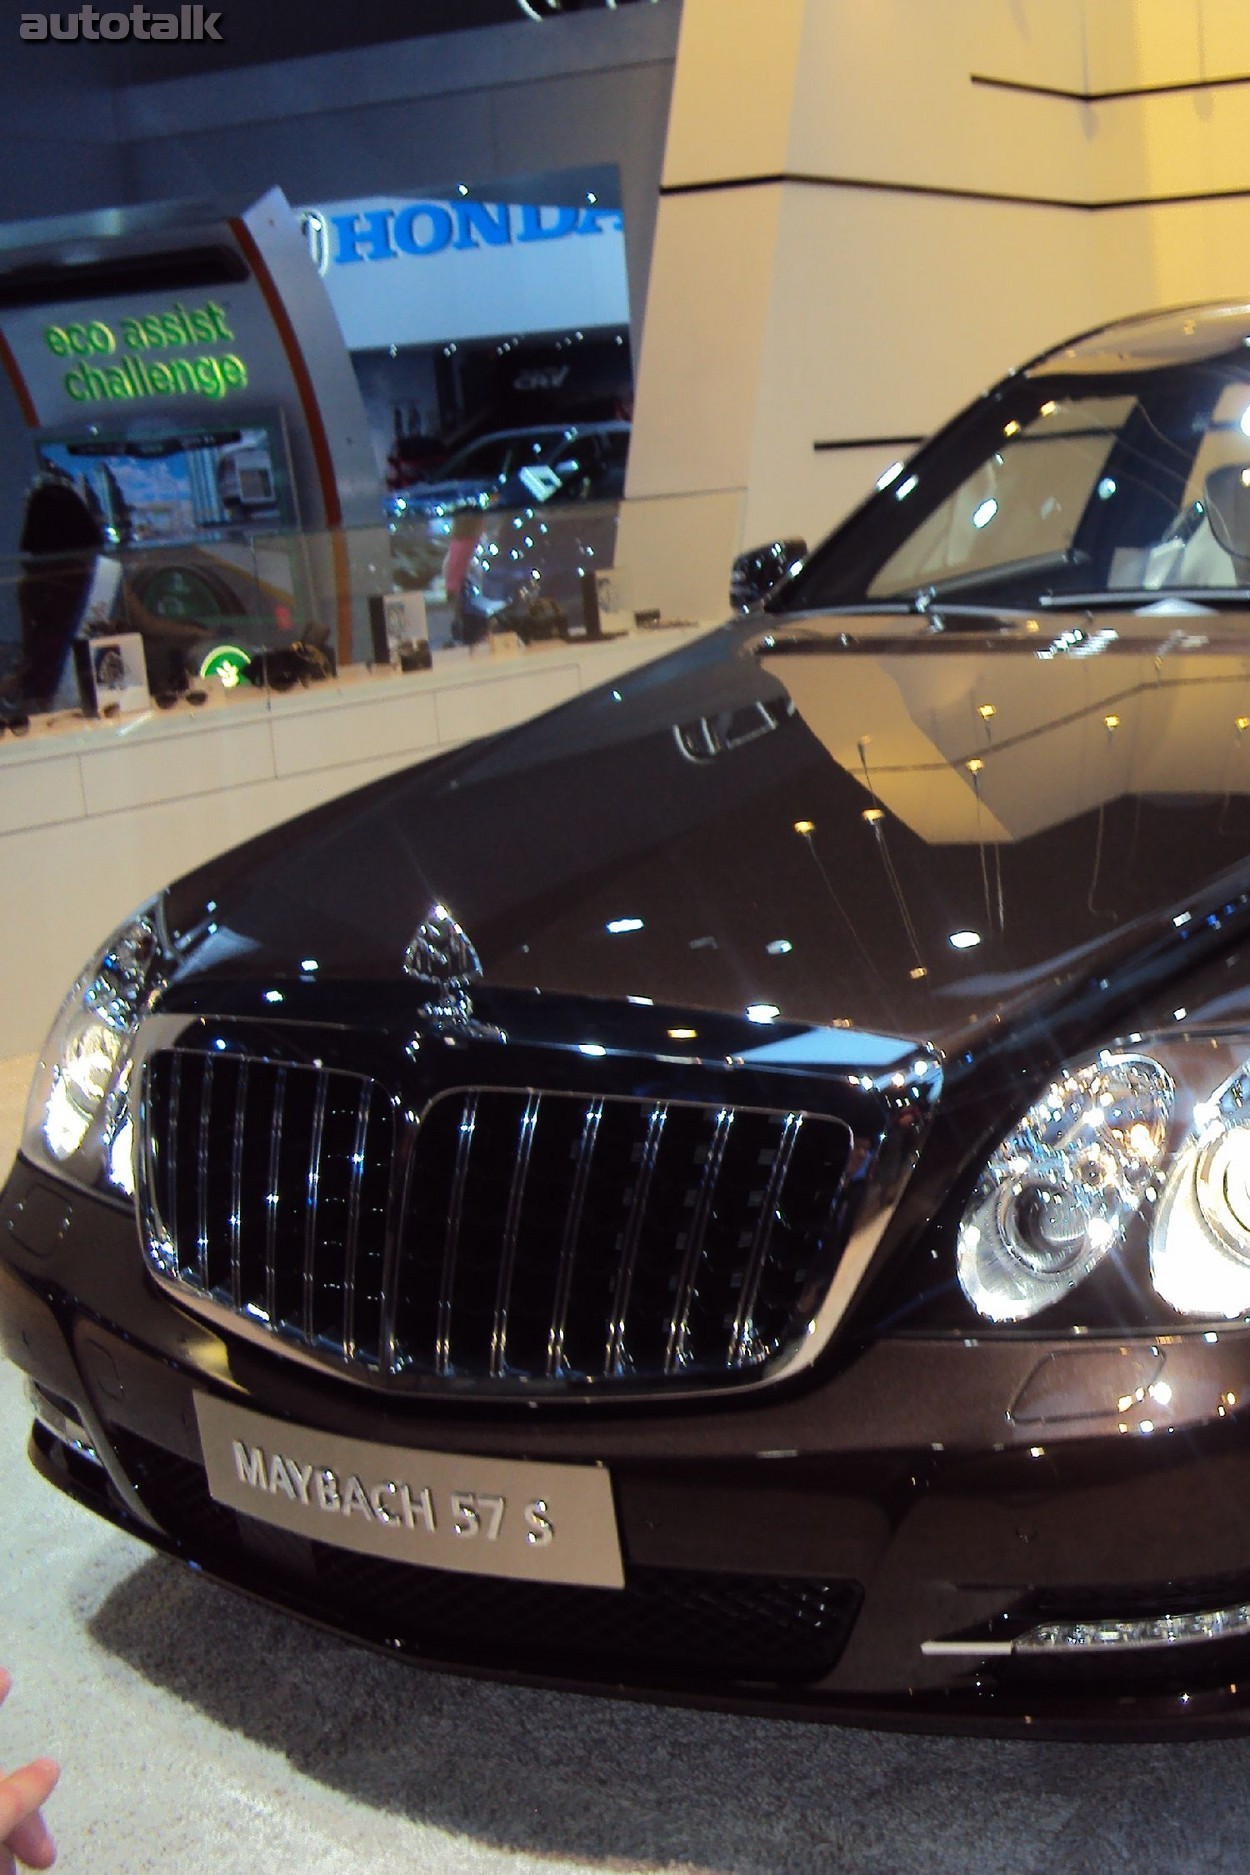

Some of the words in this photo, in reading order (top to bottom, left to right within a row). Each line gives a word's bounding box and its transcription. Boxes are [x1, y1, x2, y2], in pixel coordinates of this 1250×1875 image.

[45, 320, 116, 357] eco
[120, 301, 235, 349] assist
[65, 353, 248, 402] challenge
[231, 1438, 436, 1534] MAYBACH
[450, 1491, 506, 1541] 57
[524, 1499, 555, 1548] S
